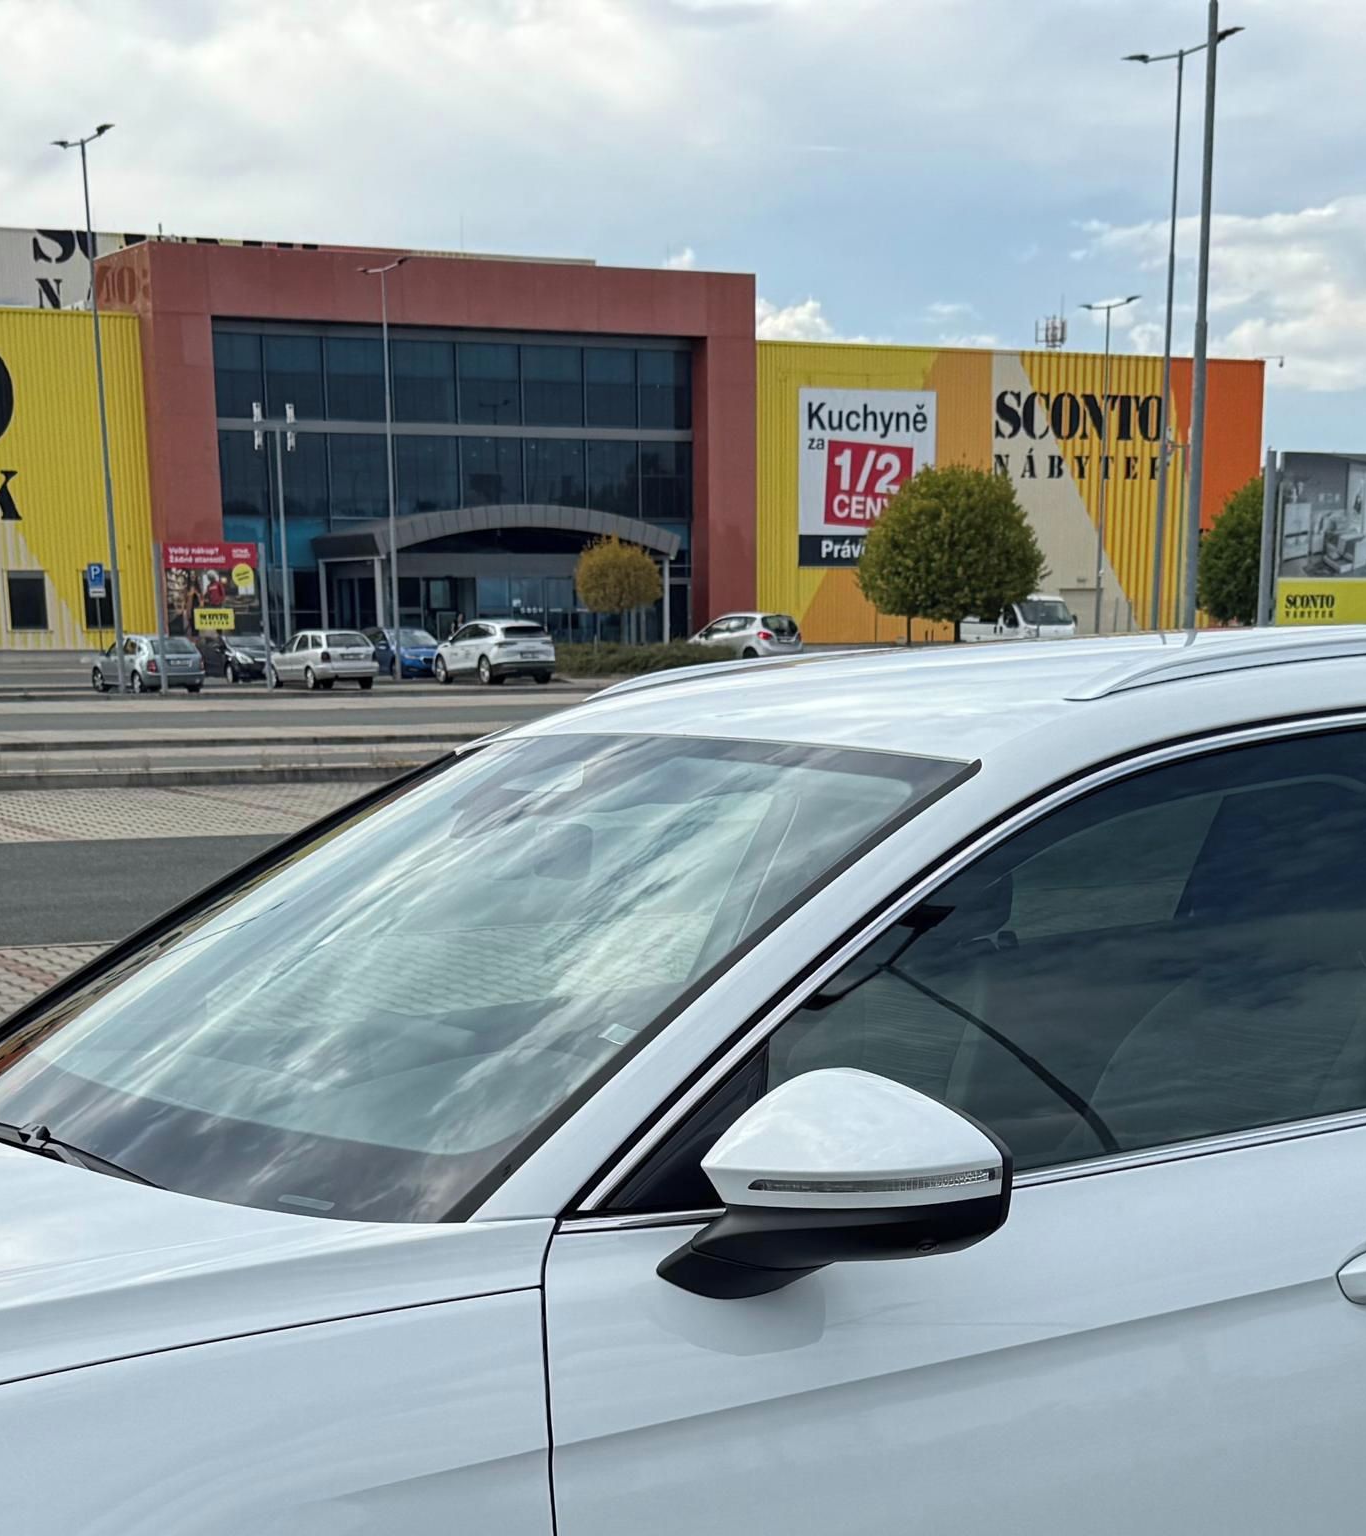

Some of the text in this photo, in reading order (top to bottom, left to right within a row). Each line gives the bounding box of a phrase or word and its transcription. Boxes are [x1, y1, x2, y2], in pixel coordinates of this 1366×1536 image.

[807, 401, 928, 439] Kuchyně
[994, 390, 1163, 442] SCONTO
[808, 437, 825, 450] za
[834, 447, 902, 495] 1/2
[90, 565, 101, 581] P
[1285, 594, 1335, 609] SCONTO
